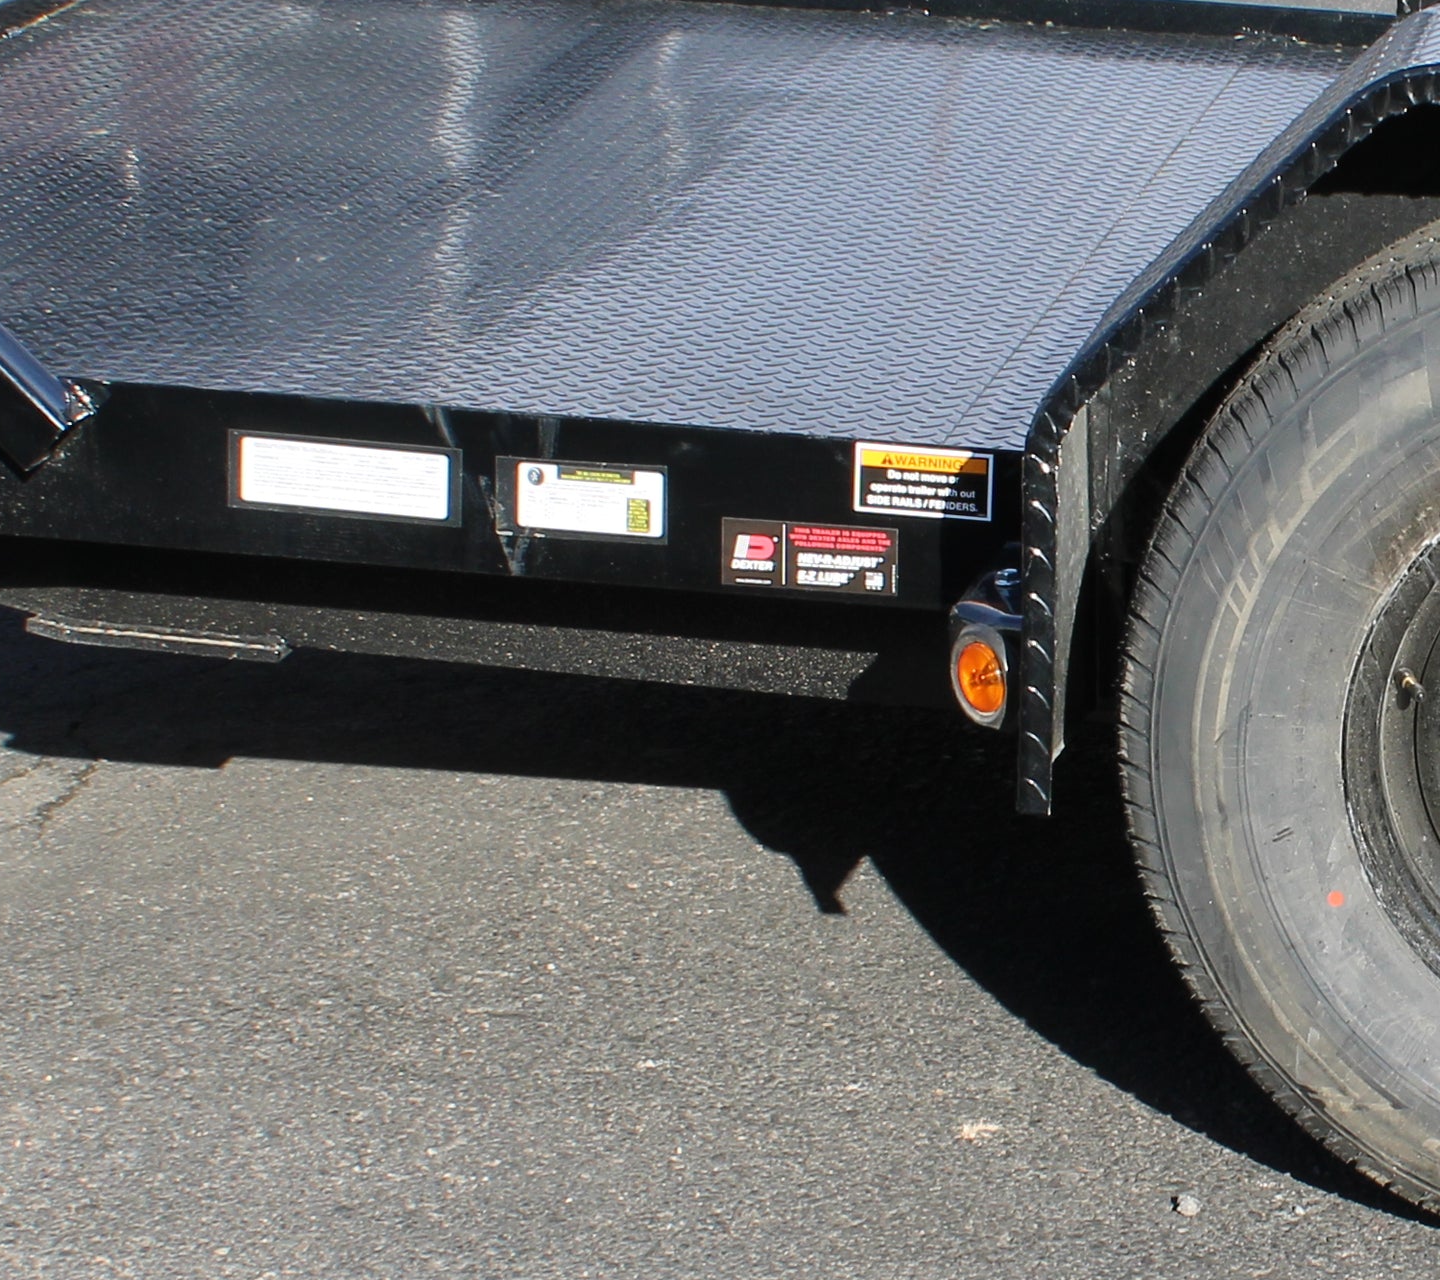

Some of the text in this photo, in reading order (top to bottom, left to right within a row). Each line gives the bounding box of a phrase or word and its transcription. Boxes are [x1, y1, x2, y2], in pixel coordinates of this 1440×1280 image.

[895, 454, 963, 471] WARNING
[887, 469, 902, 480] Do
[903, 471, 919, 481] not
[920, 473, 947, 483] move
[870, 483, 976, 498] operate trailer with out
[866, 494, 890, 506] SIDE
[891, 496, 922, 508] RAILS
[731, 559, 774, 571] DEXTER
